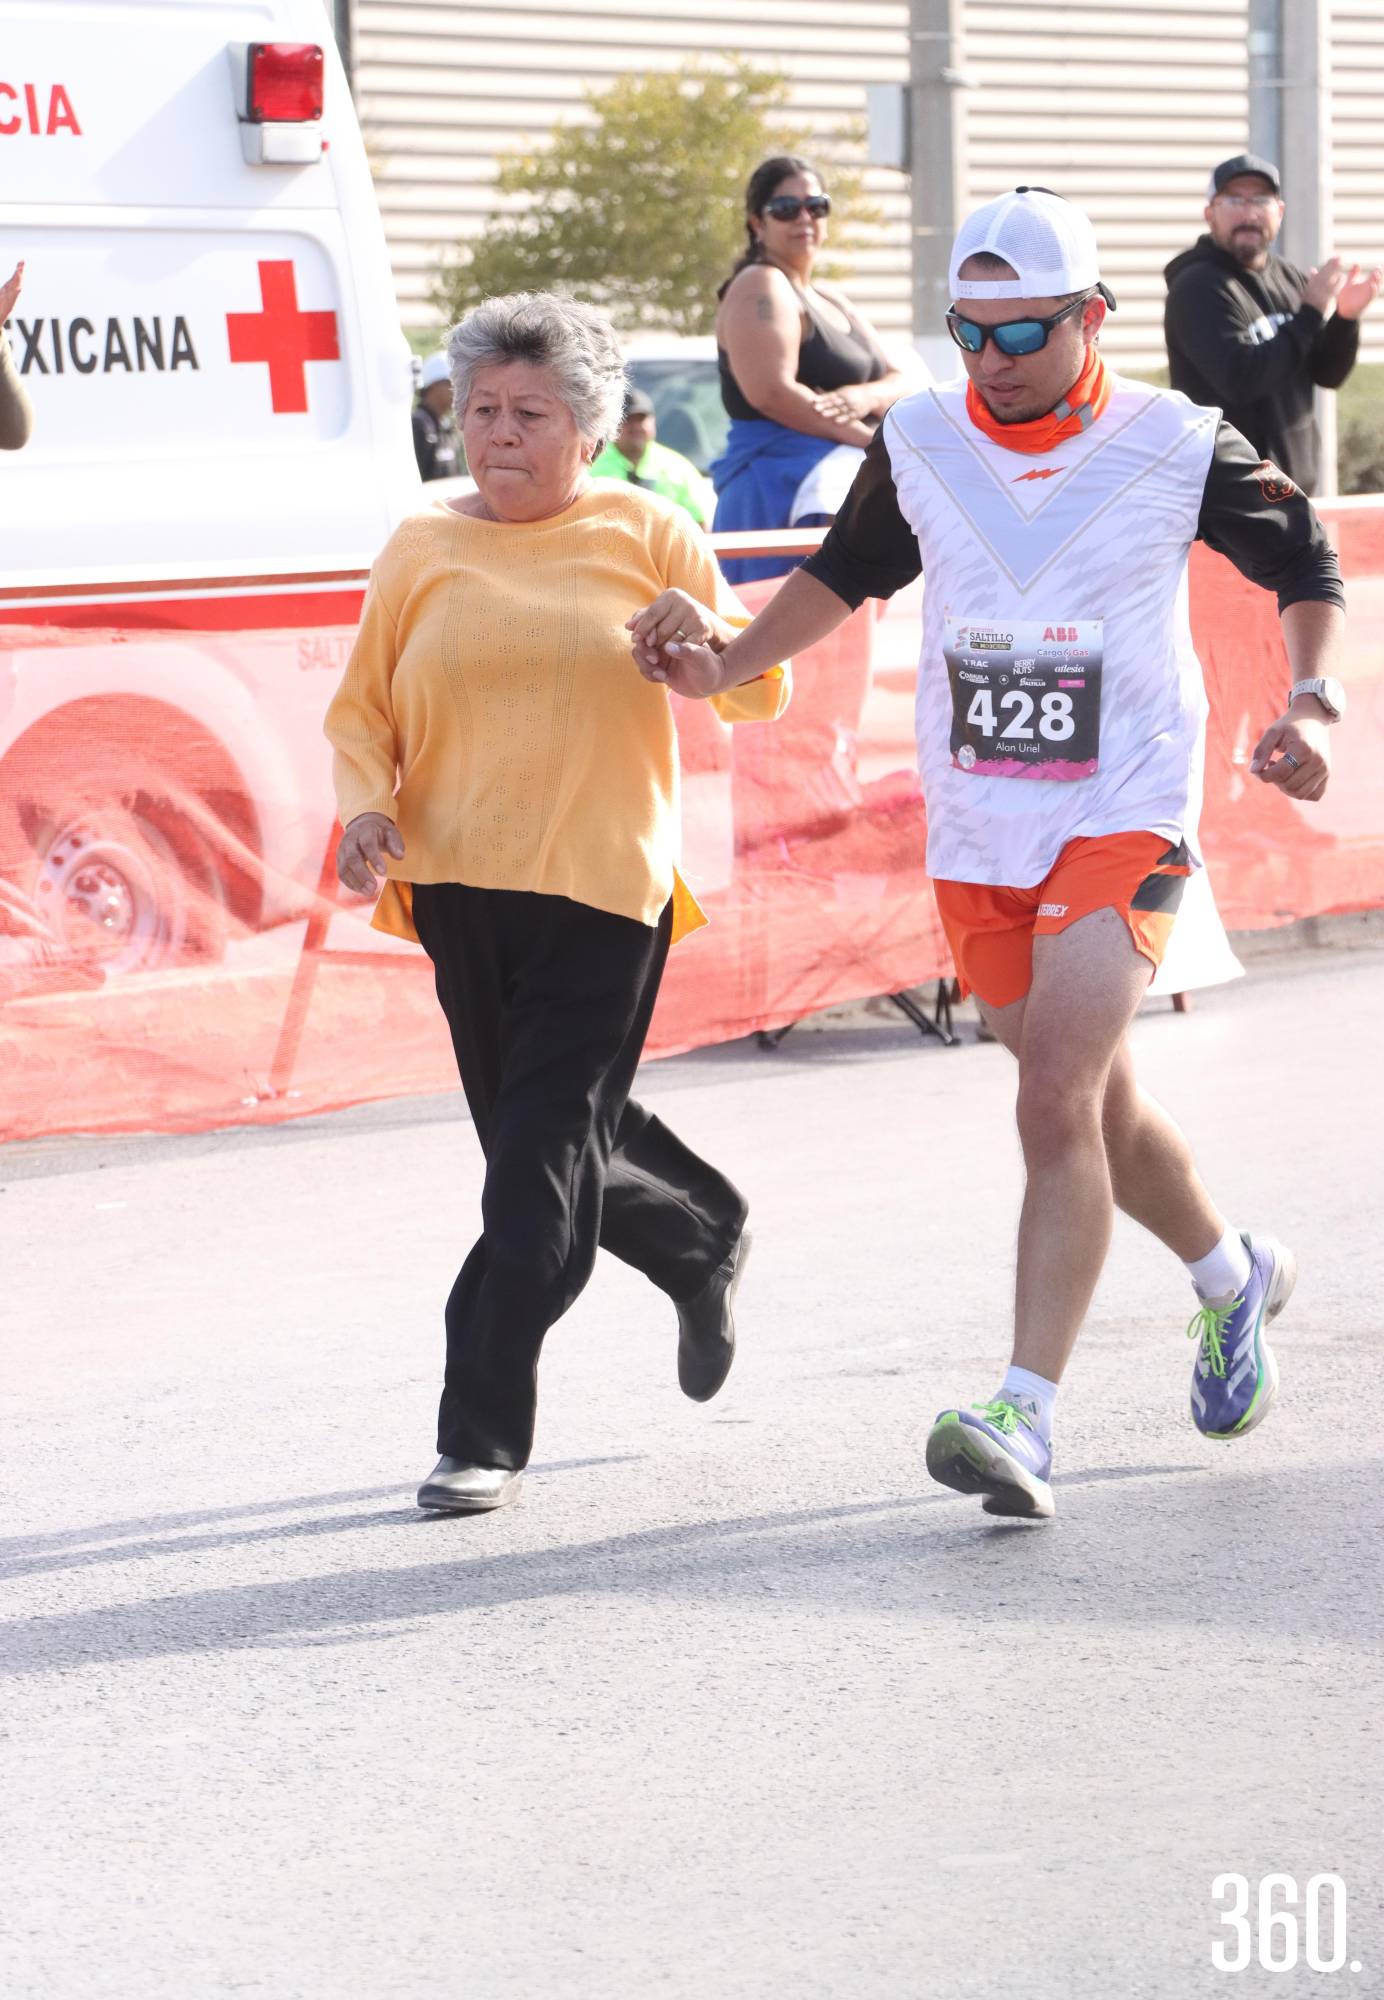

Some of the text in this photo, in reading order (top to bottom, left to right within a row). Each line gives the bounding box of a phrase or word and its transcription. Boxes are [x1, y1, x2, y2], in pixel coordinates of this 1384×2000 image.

[0, 82, 82, 136] CIA
[969, 631, 1014, 643] SALTILLO
[1042, 626, 1079, 642] ABB
[1036, 648, 1089, 658] Cargo Gas
[967, 689, 1076, 742] 428
[995, 742, 1041, 754] Alan Uriel
